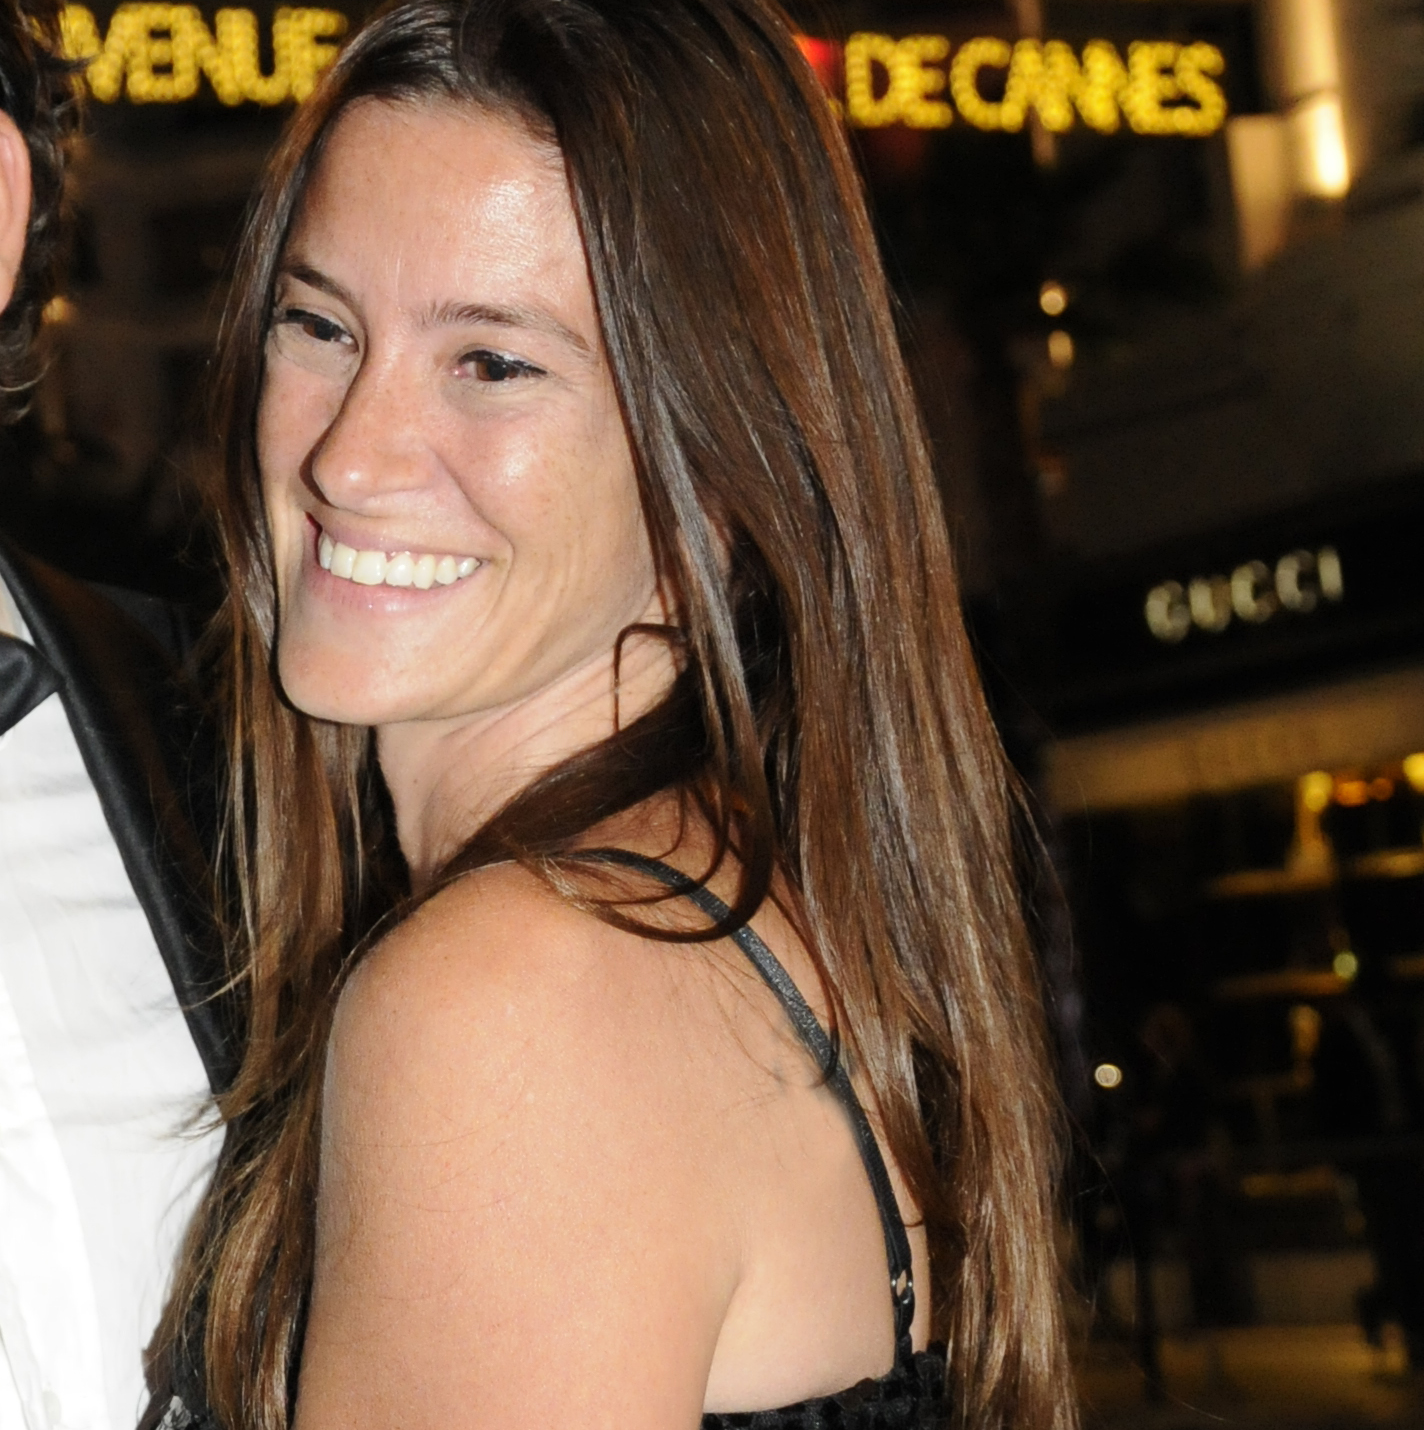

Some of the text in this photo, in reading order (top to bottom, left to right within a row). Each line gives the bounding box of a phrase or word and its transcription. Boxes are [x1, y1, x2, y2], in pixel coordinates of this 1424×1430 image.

[844, 31, 953, 130] DE
[950, 37, 1226, 137] CANNES
[1143, 544, 1346, 644] GUCCI
